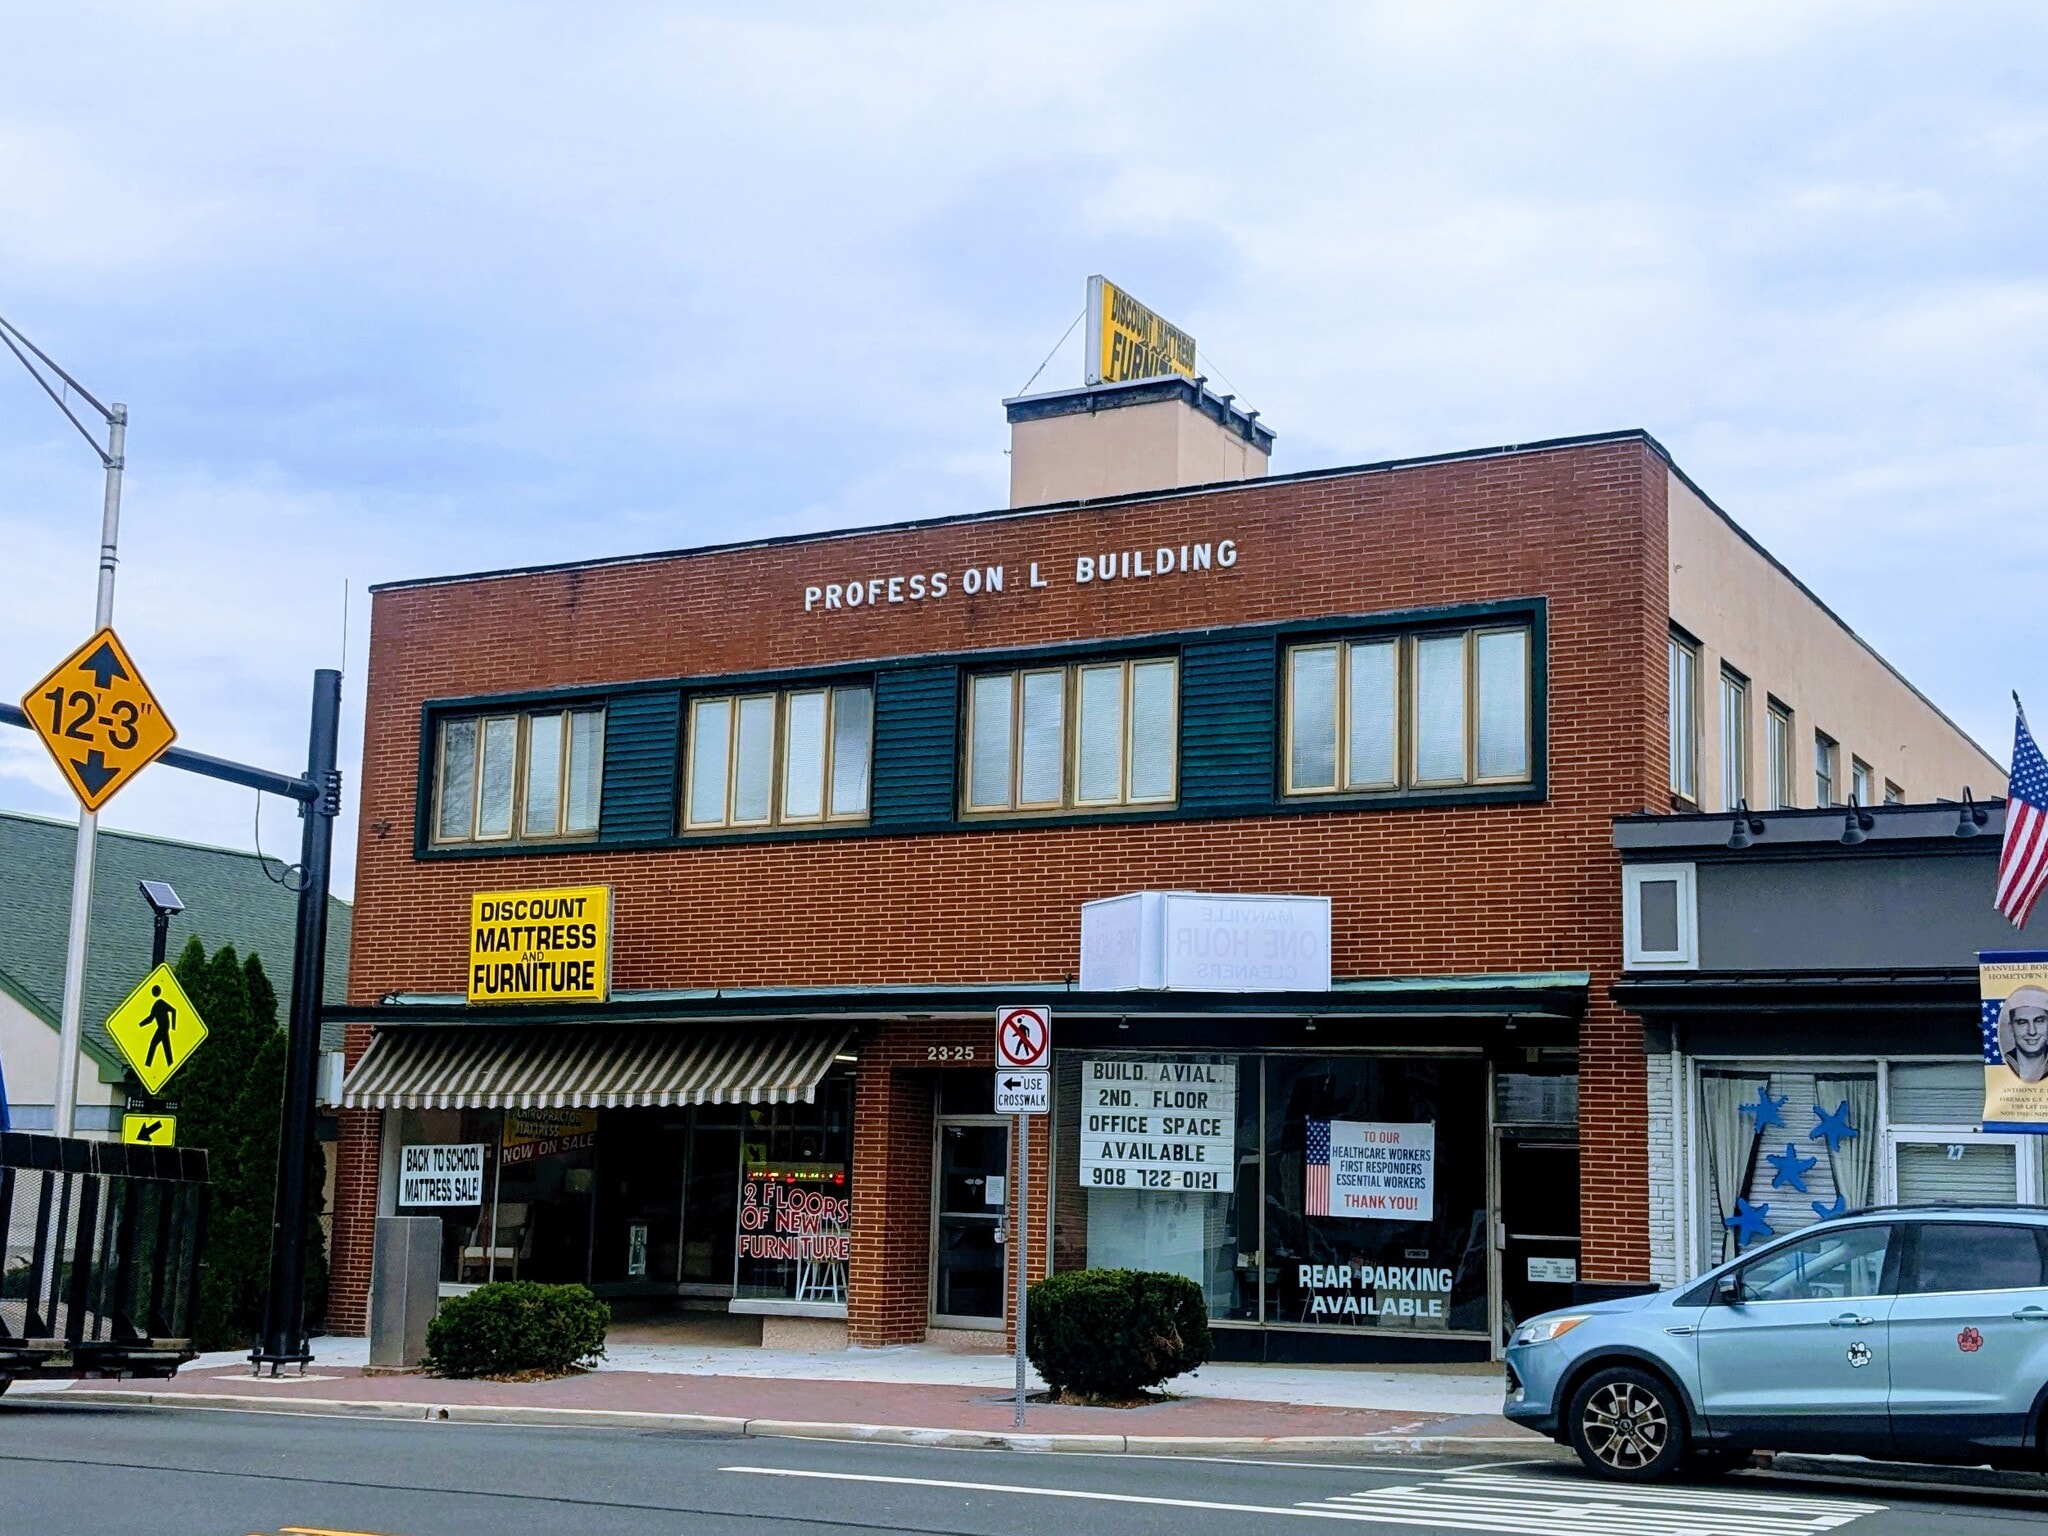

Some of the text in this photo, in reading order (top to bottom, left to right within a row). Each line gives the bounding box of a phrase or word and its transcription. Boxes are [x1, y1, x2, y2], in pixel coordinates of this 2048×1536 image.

[1111, 289, 1153, 344] DISCOUNT
[804, 572, 948, 612] PROFESS
[963, 566, 1003, 595] ON
[1075, 540, 1238, 584] BUILDING
[481, 898, 587, 922] DISCOUNT
[475, 923, 597, 952] MATTRESS
[521, 951, 544, 962] AND
[473, 960, 595, 994] FURNITURE
[927, 1046, 975, 1060] 23-25
[1093, 1062, 1223, 1083] BUILD. AVIAL.
[1023, 1078, 1042, 1090] USE
[998, 1094, 1046, 1106] CROSSWALK
[1099, 1089, 1208, 1109] 2ND. FLOOR
[1089, 1115, 1221, 1136] OFFICE SPACE
[503, 1133, 595, 1163] NOW ON SALE
[1363, 1131, 1400, 1144] TO OUR
[406, 1147, 480, 1172] BACK TO SCHOOL
[1101, 1142, 1205, 1162] AVAILABLE
[1332, 1146, 1431, 1162] HEALTHCARE WORKERS
[1092, 1168, 1126, 1185] 908
[1340, 1161, 1422, 1175] FIRST RESPONDERS
[405, 1178, 452, 1202] MATTRESS
[1336, 1174, 1426, 1189] ESSENTIAL WORKERS
[744, 1182, 849, 1224] 2 FLOORS
[1344, 1194, 1418, 1211] THANK YOU!
[741, 1206, 820, 1235] OF NEW
[738, 1234, 849, 1260] FURNITURE
[1299, 1264, 1453, 1292] REAR PARKING
[1311, 1295, 1442, 1318] AVAILABLE
